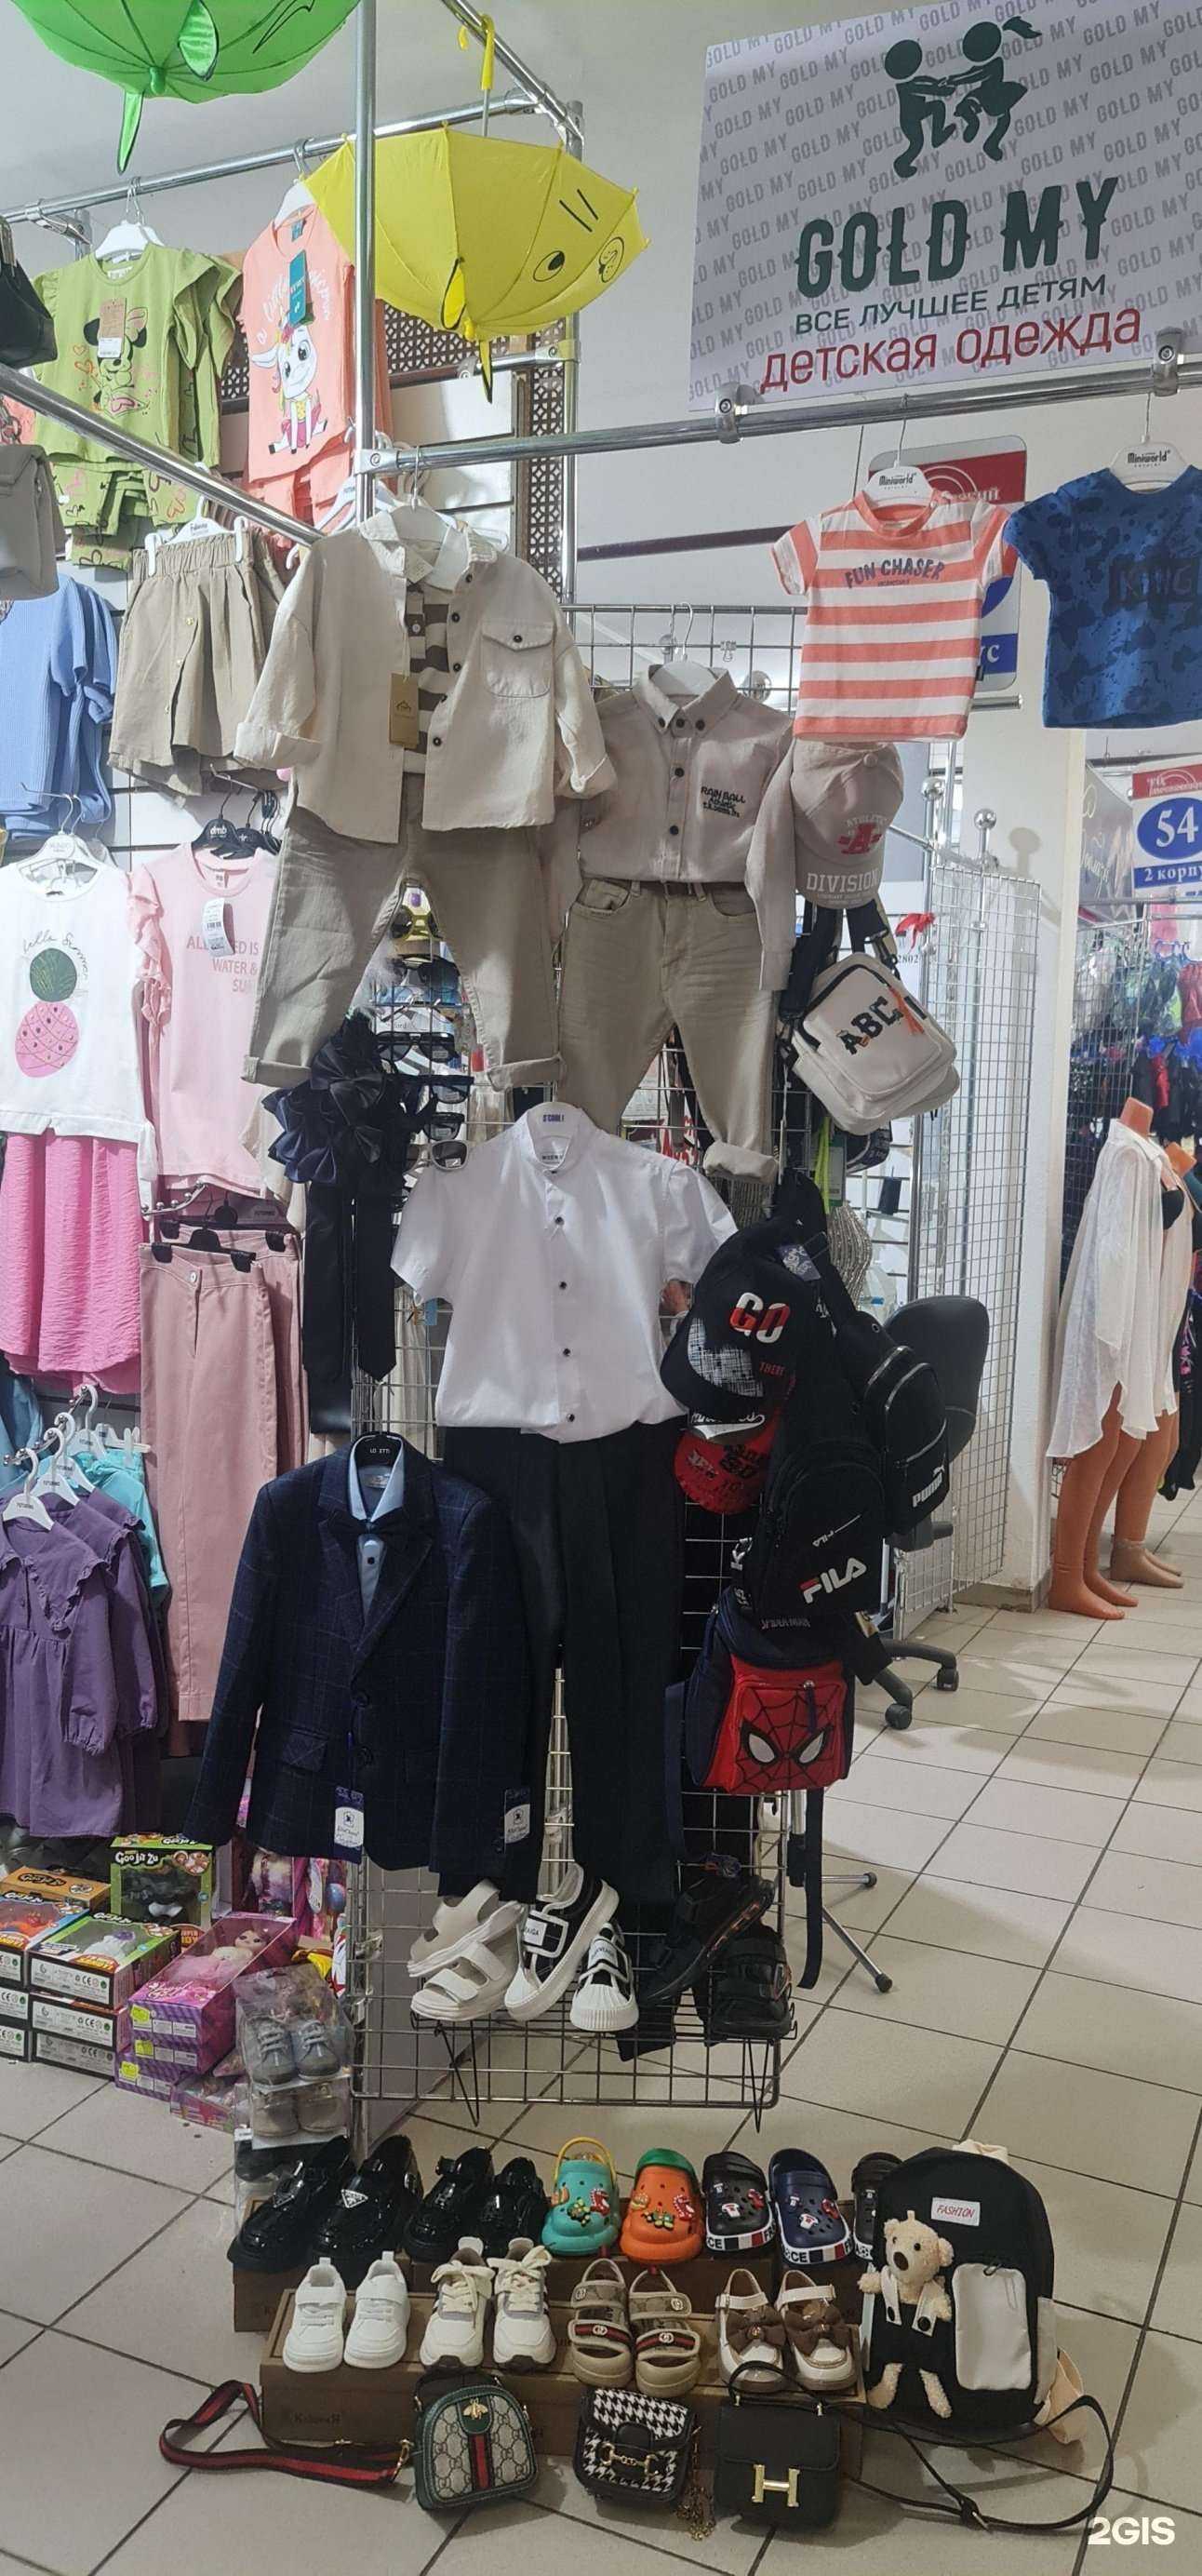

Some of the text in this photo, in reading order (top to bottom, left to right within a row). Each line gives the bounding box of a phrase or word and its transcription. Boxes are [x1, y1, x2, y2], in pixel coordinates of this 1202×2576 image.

[845, 16, 884, 45] GOLD
[919, 1, 960, 31] GOLD
[1050, 16, 1075, 42] MY
[1083, 1, 1159, 45] GOLD MY
[709, 61, 775, 103] GOLD MY
[780, 47, 848, 89] GOLD MY
[850, 53, 885, 81] GOL
[1057, 54, 1081, 79] MY
[1090, 40, 1166, 84] GOLD MY
[1170, 50, 1202, 76] GOL
[715, 97, 781, 139] GOLD MY
[786, 84, 853, 126] GOLD MY
[1014, 92, 1088, 136] GOLD MY
[1097, 78, 1173, 123] GOLD MY
[720, 134, 787, 175] GOLD MY
[792, 121, 860, 163] GOLD MY
[1022, 132, 1095, 175] GOLD MY
[1104, 117, 1181, 162] GOLD MY
[797, 158, 866, 201] GOLD MY
[944, 152, 986, 182] GOLD
[1155, 153, 1182, 178] MY
[701, 179, 723, 201] MY
[726, 171, 793, 212] GOLD MY
[707, 214, 729, 238] MY
[732, 208, 799, 250] GOLD MY
[1111, 193, 1189, 236] GOLD MY
[795, 177, 1119, 299] GOLD MY
[1118, 233, 1195, 275] GOLD MY
[713, 252, 736, 275] MY
[739, 259, 776, 288] GOLD
[959, 265, 999, 292] GOLD
[720, 290, 741, 314] MY
[745, 297, 781, 326] GOLD
[796, 275, 1106, 334] ВСЕ ЛУЧШЕЕ ДЕТЯМ
[720, 323, 743, 348] MY
[746, 330, 782, 358] GOLD
[760, 308, 1141, 395] детская одежда
[845, 558, 945, 588] FUN CHASER
[1155, 804, 1199, 848] 54
[806, 867, 879, 892] DIVISION
[1144, 867, 1153, 881] 2
[212, 959, 247, 975] WATER
[836, 996, 904, 1054] ABC
[730, 1292, 790, 1344] GO
[913, 1472, 942, 1509] PUMA
[798, 1557, 867, 1604] FILA
[936, 2205, 976, 2219] FASHION
